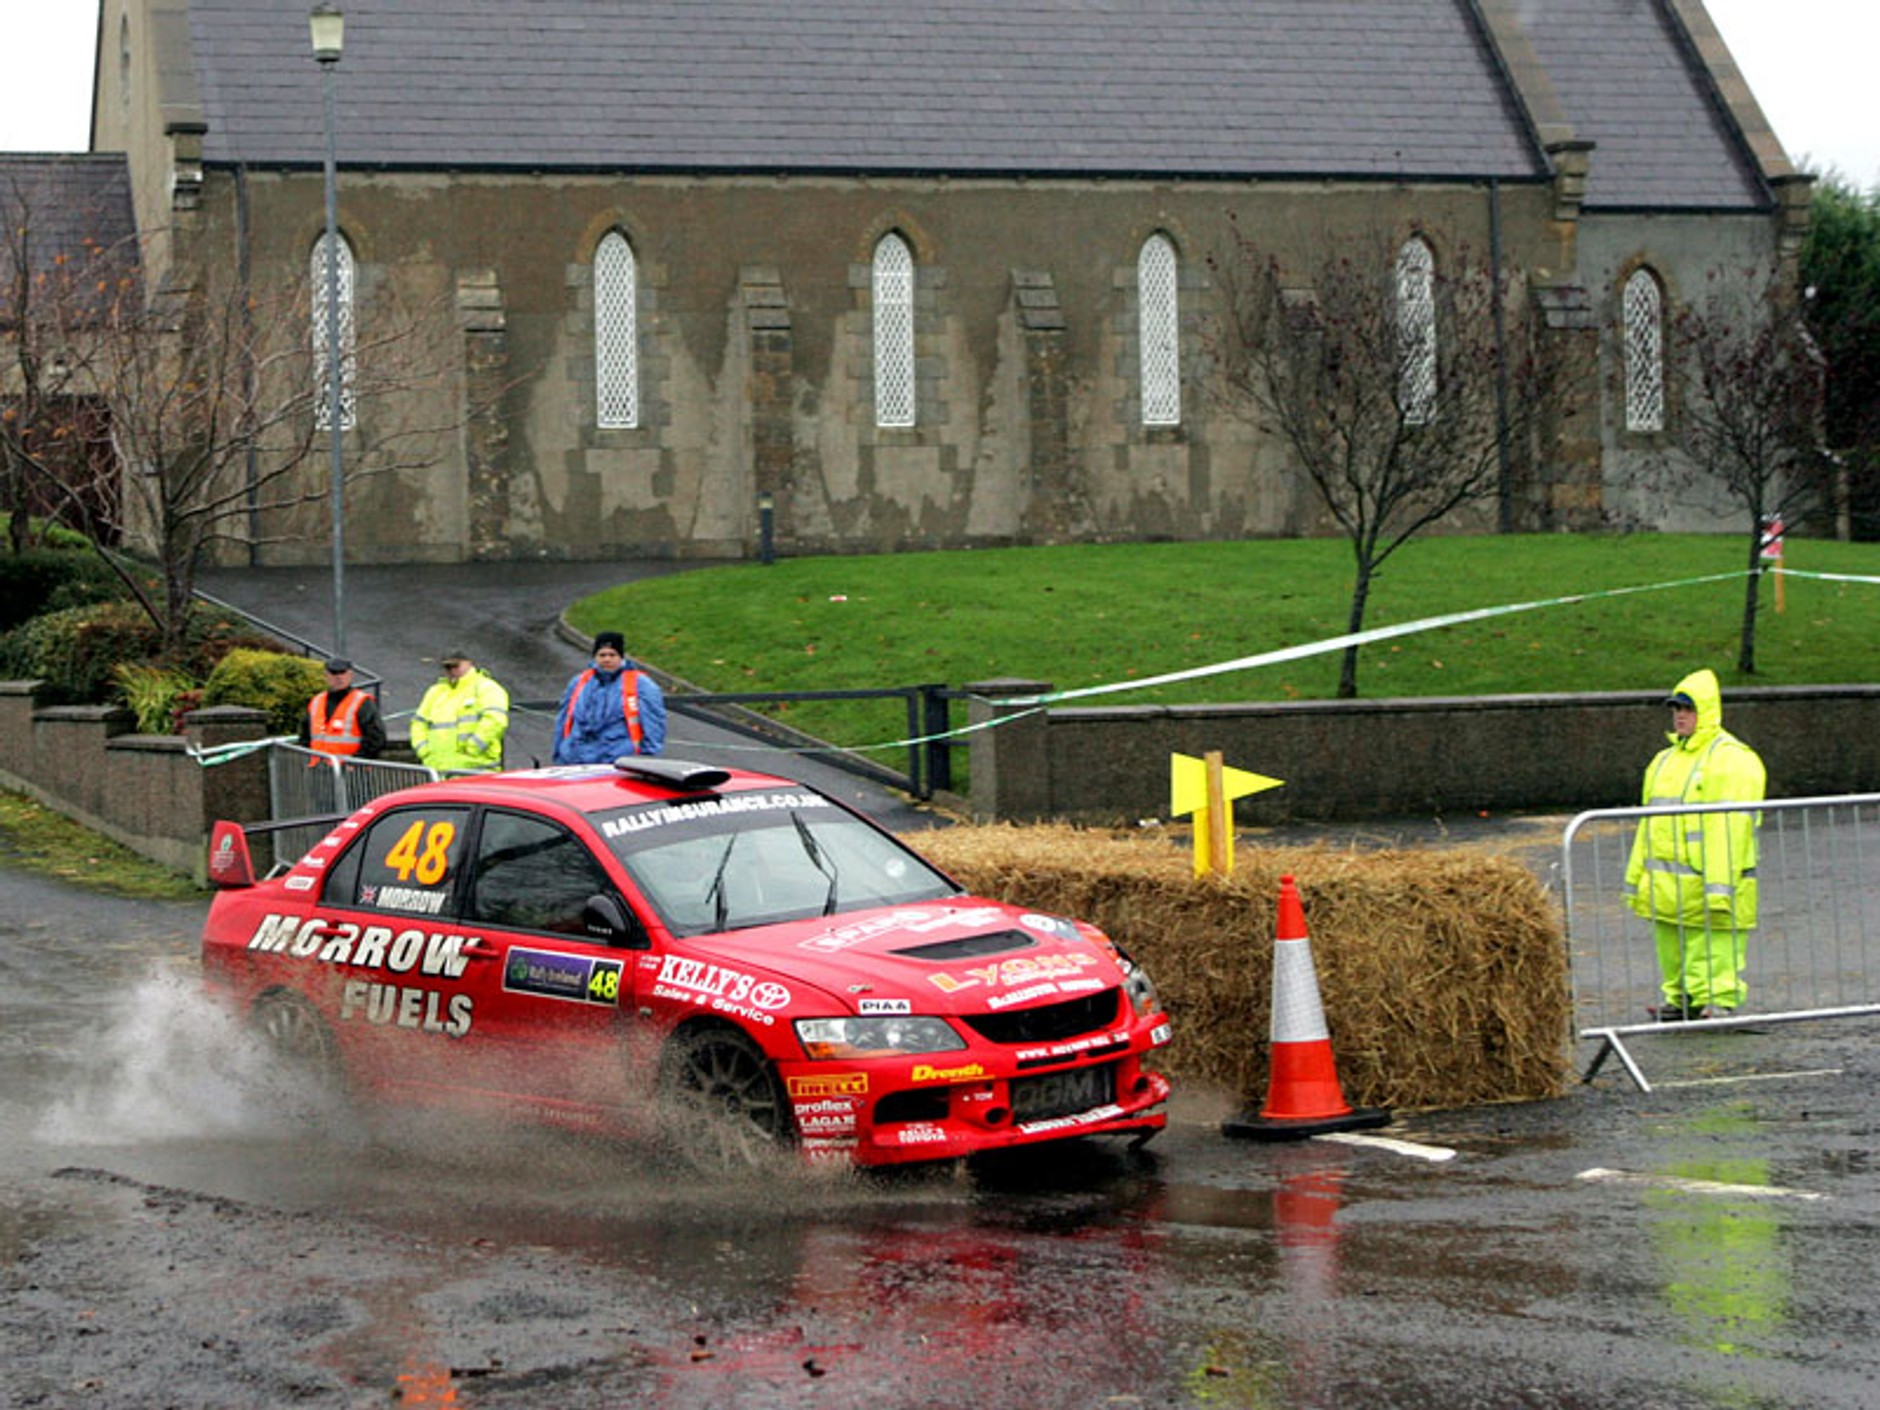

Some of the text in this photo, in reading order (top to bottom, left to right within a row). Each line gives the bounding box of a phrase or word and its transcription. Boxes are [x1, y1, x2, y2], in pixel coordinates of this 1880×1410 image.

[385, 820, 455, 885] 48
[376, 886, 445, 914] MORROW
[248, 914, 481, 977] MORROW
[588, 970, 618, 998] 48
[657, 954, 755, 1000] KELLY'S
[340, 982, 473, 1038] FUELS
[652, 984, 691, 1002] Sales
[712, 998, 775, 1025] Service
[861, 1001, 909, 1013] PIAA
[912, 1064, 984, 1082] Drenth
[794, 1100, 852, 1116] proflex
